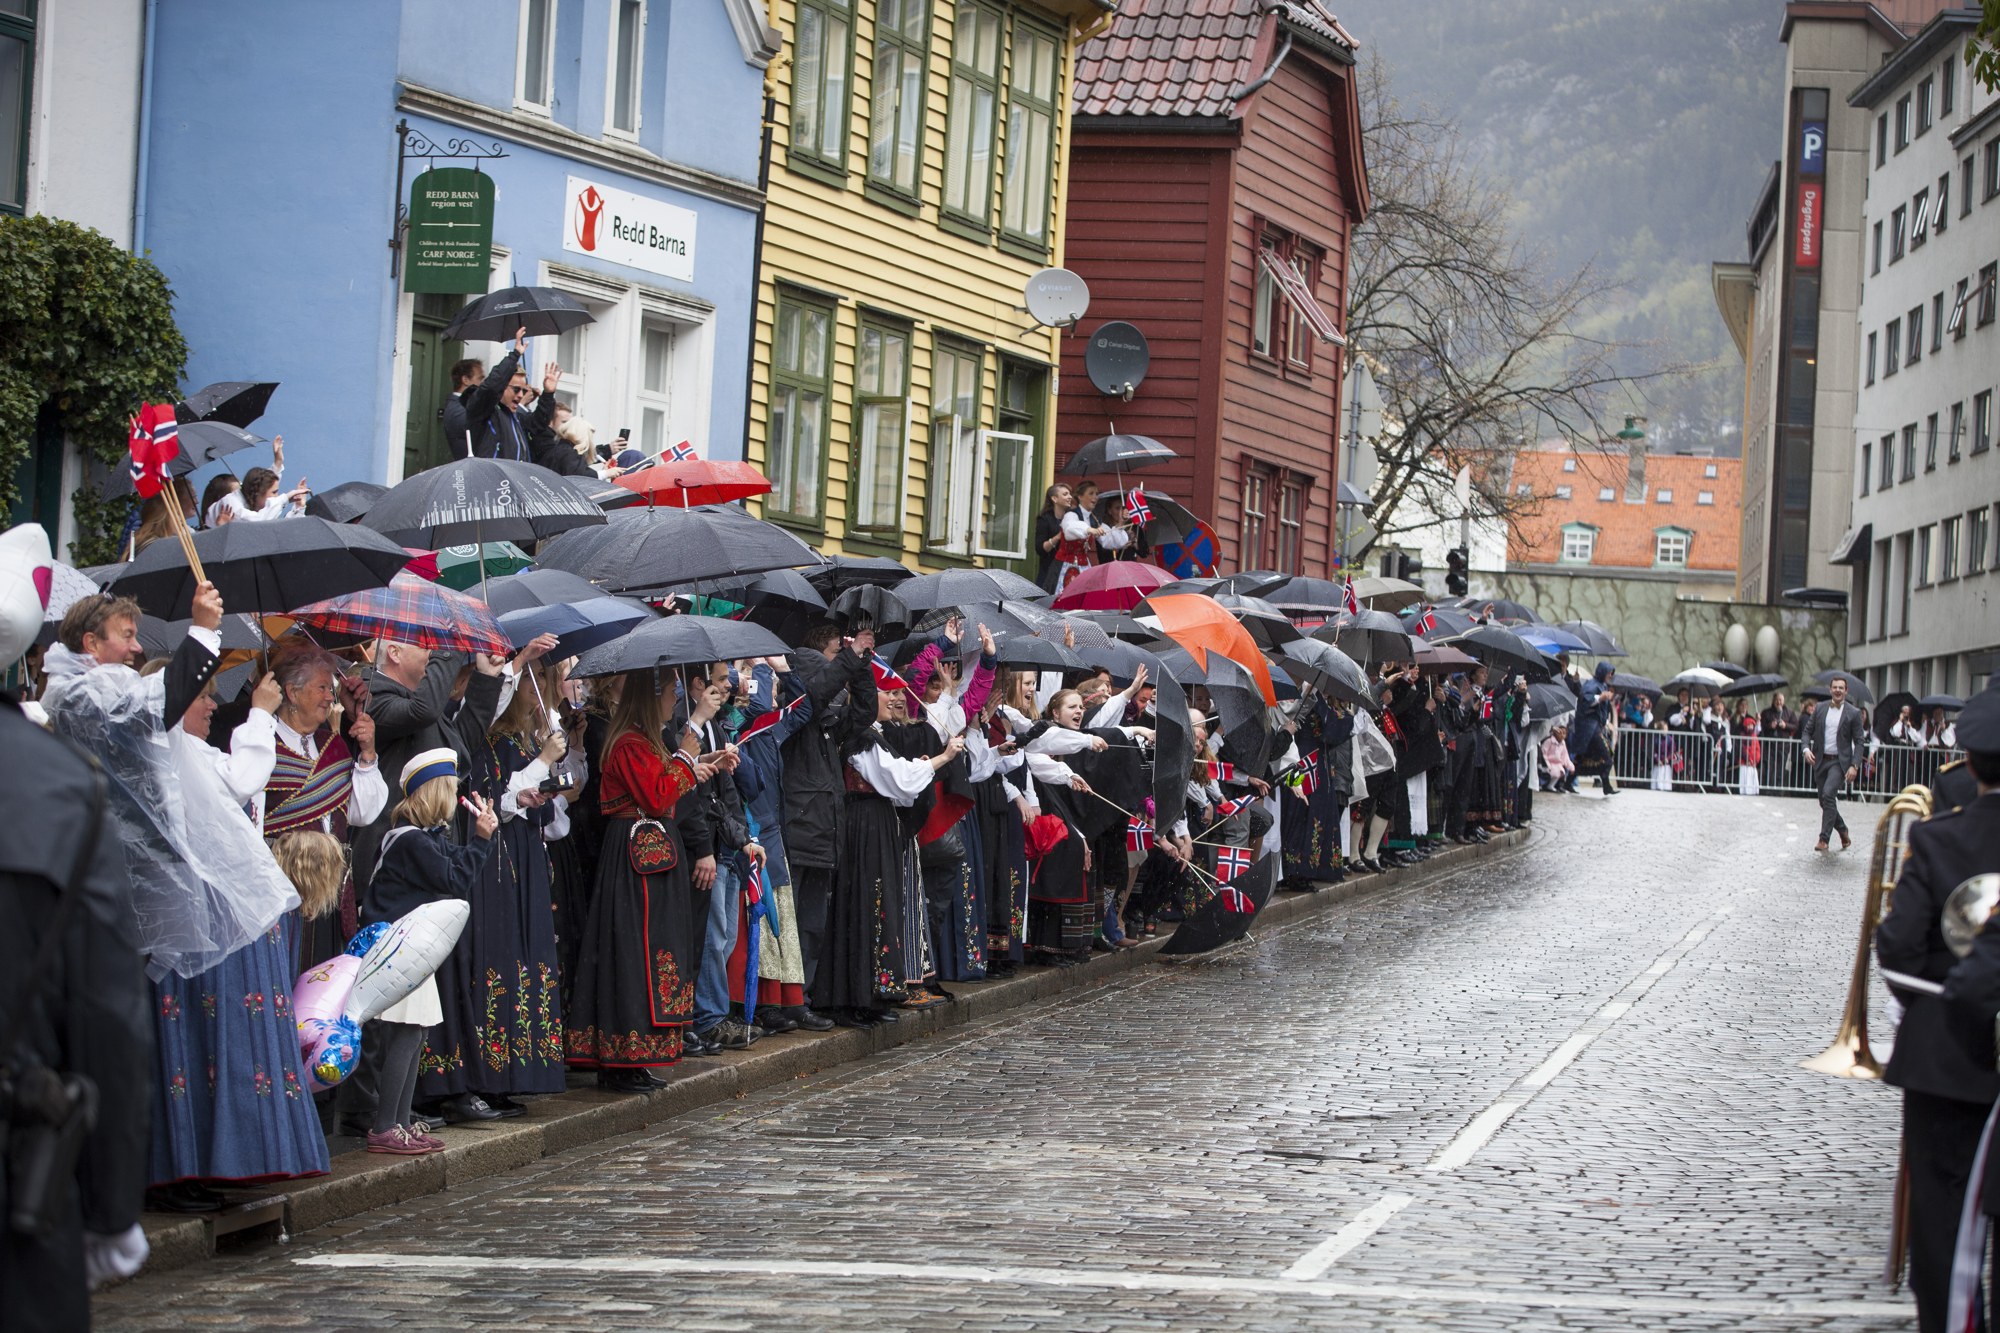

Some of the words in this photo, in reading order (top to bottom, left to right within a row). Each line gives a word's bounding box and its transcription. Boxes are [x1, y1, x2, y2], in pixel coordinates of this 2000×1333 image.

[1804, 133, 1822, 160] P
[426, 191, 449, 199] REDD
[451, 191, 479, 199] BARNA
[431, 200, 456, 209] region
[613, 215, 646, 245] Redd
[649, 225, 686, 257] Barna
[423, 250, 444, 258] CARF
[446, 251, 475, 259] NORGE
[452, 470, 467, 509] Trondheim
[496, 479, 512, 506] Oslo
